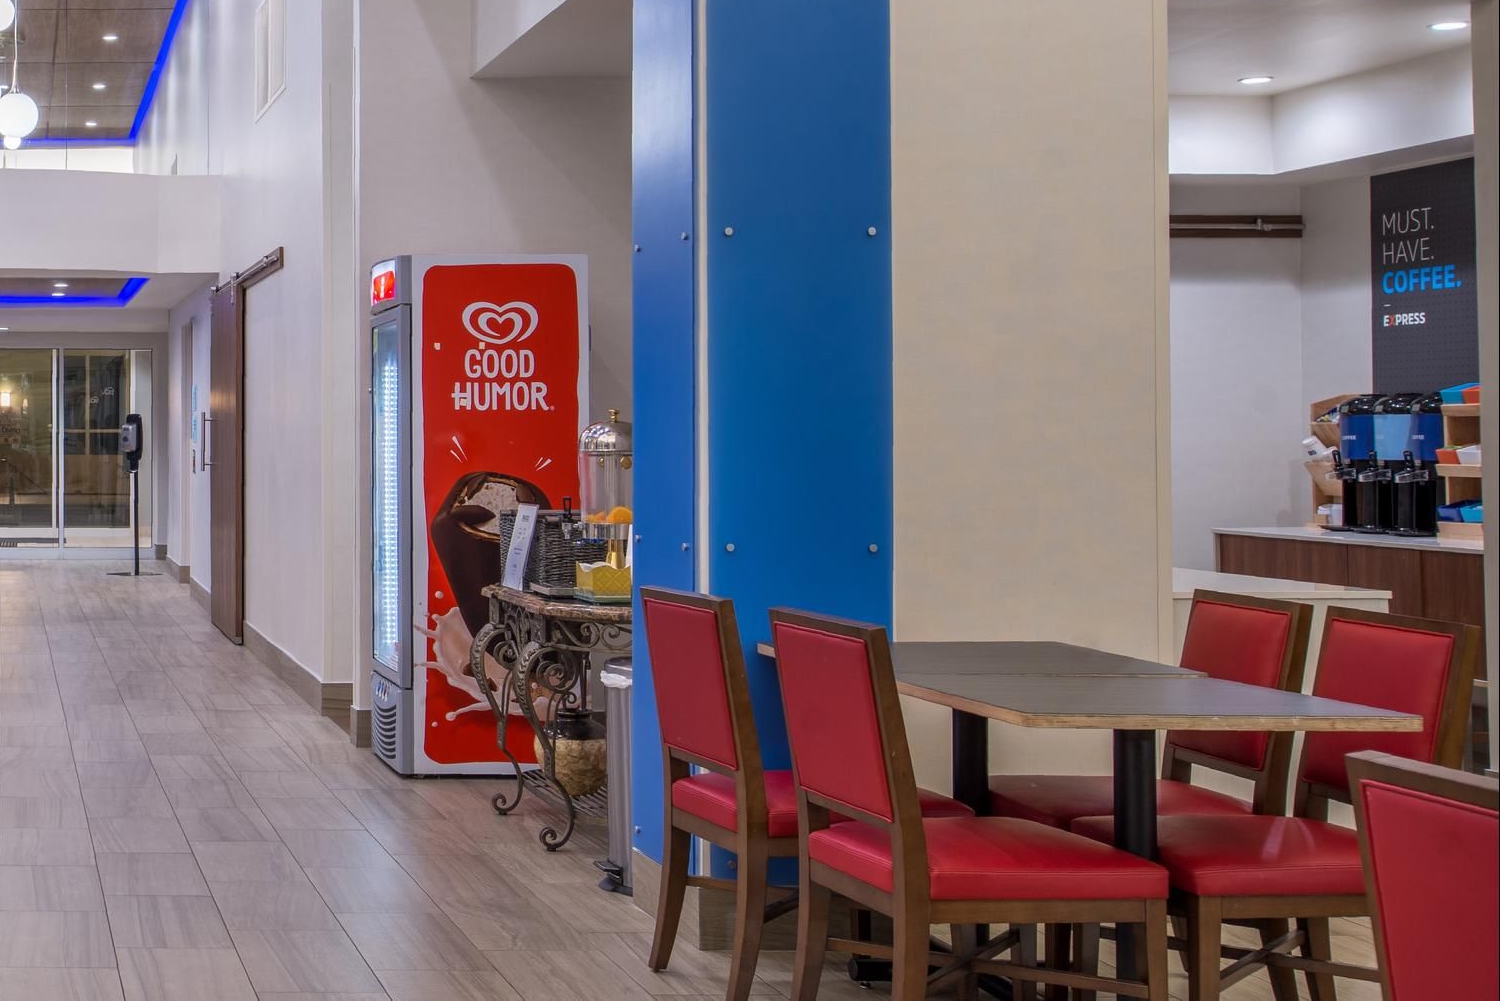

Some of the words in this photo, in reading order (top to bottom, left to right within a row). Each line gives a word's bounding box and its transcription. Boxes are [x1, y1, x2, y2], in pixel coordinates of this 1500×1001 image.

[1382, 207, 1435, 236] MUST.
[1382, 237, 1435, 265] HAVE.
[1382, 264, 1461, 294] COFFEE.
[1383, 312, 1426, 327] EXPRESS
[464, 349, 535, 379] GOOD
